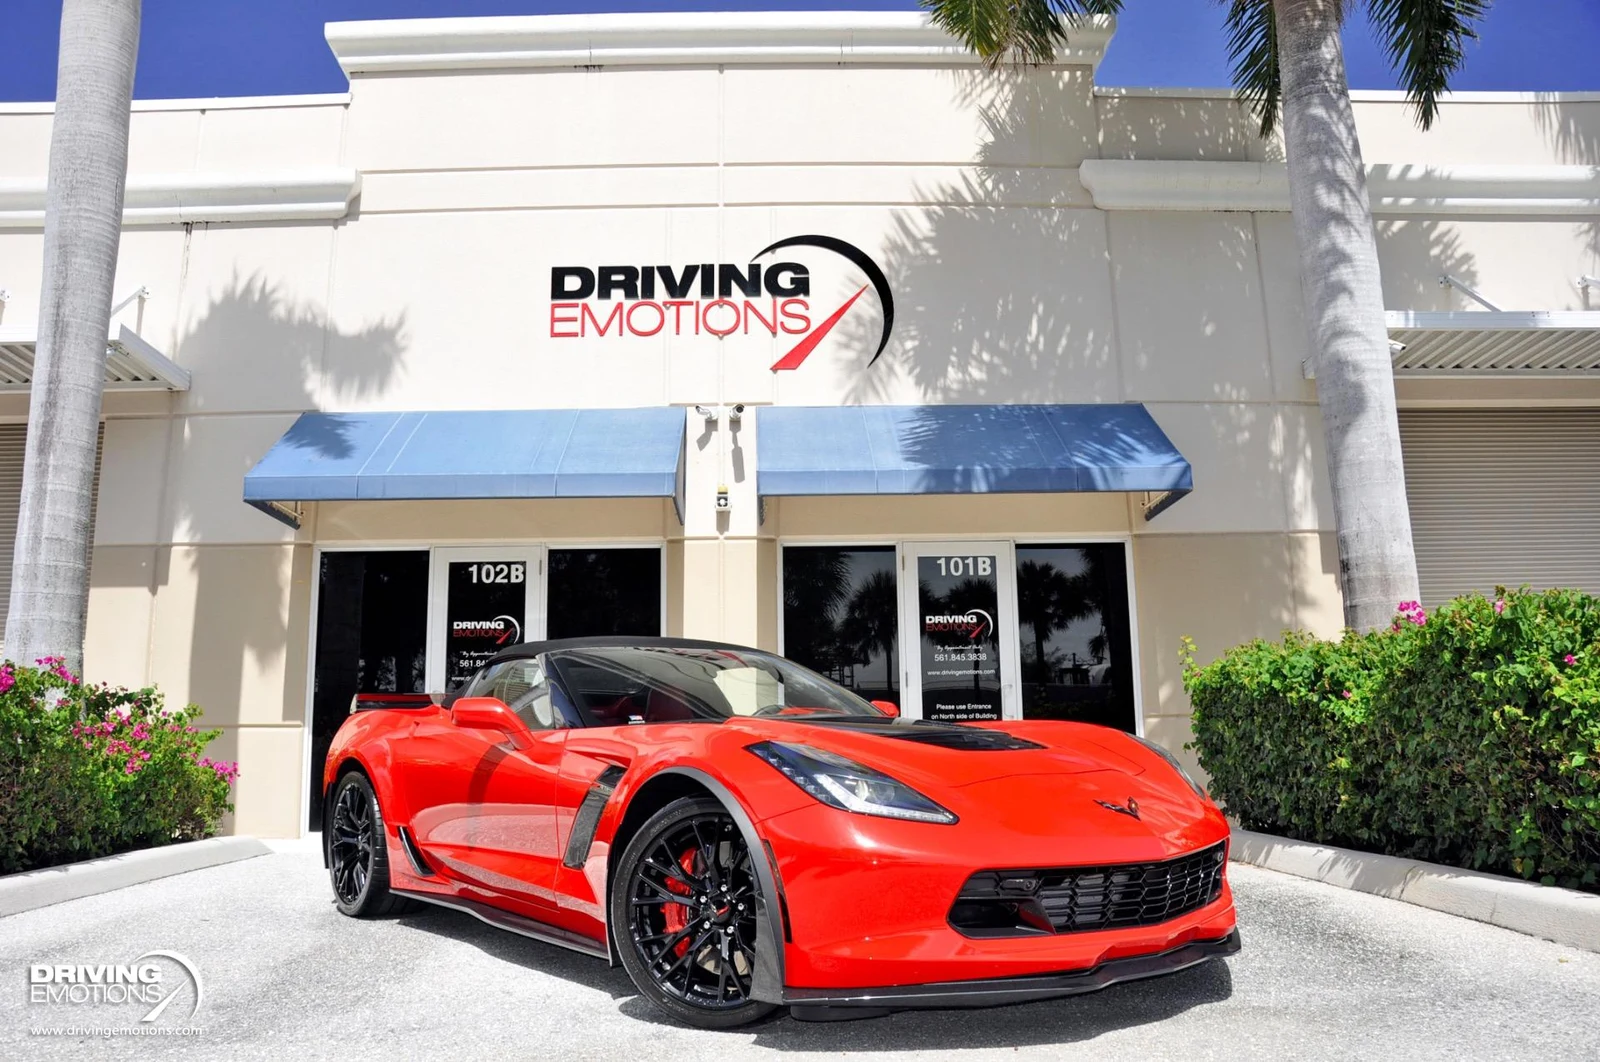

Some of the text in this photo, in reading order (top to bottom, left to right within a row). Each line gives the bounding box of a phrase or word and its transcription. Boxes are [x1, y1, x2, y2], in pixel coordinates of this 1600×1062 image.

[551, 262, 810, 301] DRIVING
[550, 299, 811, 338] EMOTIONS
[937, 557, 992, 577] 101B
[468, 564, 525, 584] 102B
[926, 615, 977, 624] DRIVING
[453, 621, 504, 630] DRIVING
[926, 623, 977, 632] EMOTIONS
[934, 653, 987, 662] 561.845.3838
[459, 659, 489, 668] 561.84
